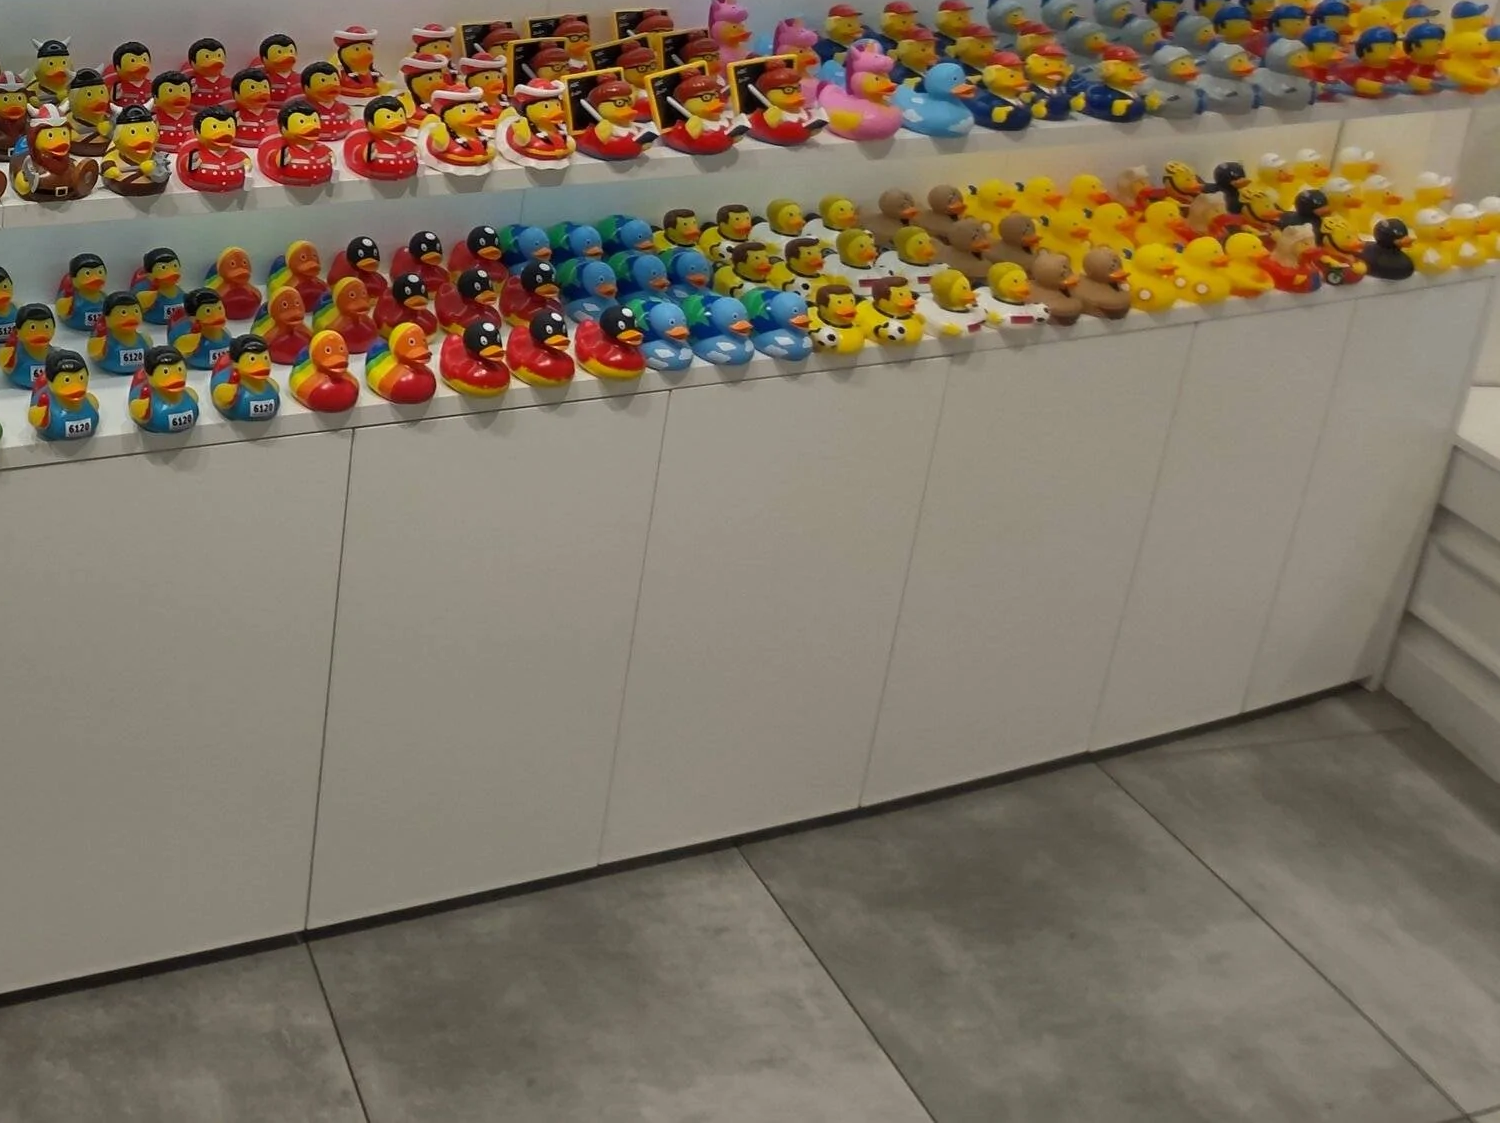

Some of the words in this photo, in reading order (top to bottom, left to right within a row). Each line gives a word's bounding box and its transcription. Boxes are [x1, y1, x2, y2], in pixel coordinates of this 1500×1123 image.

[123, 351, 143, 362] 6120
[253, 403, 274, 414] 6120
[171, 414, 193, 427] 6120
[68, 422, 90, 434] 6120
